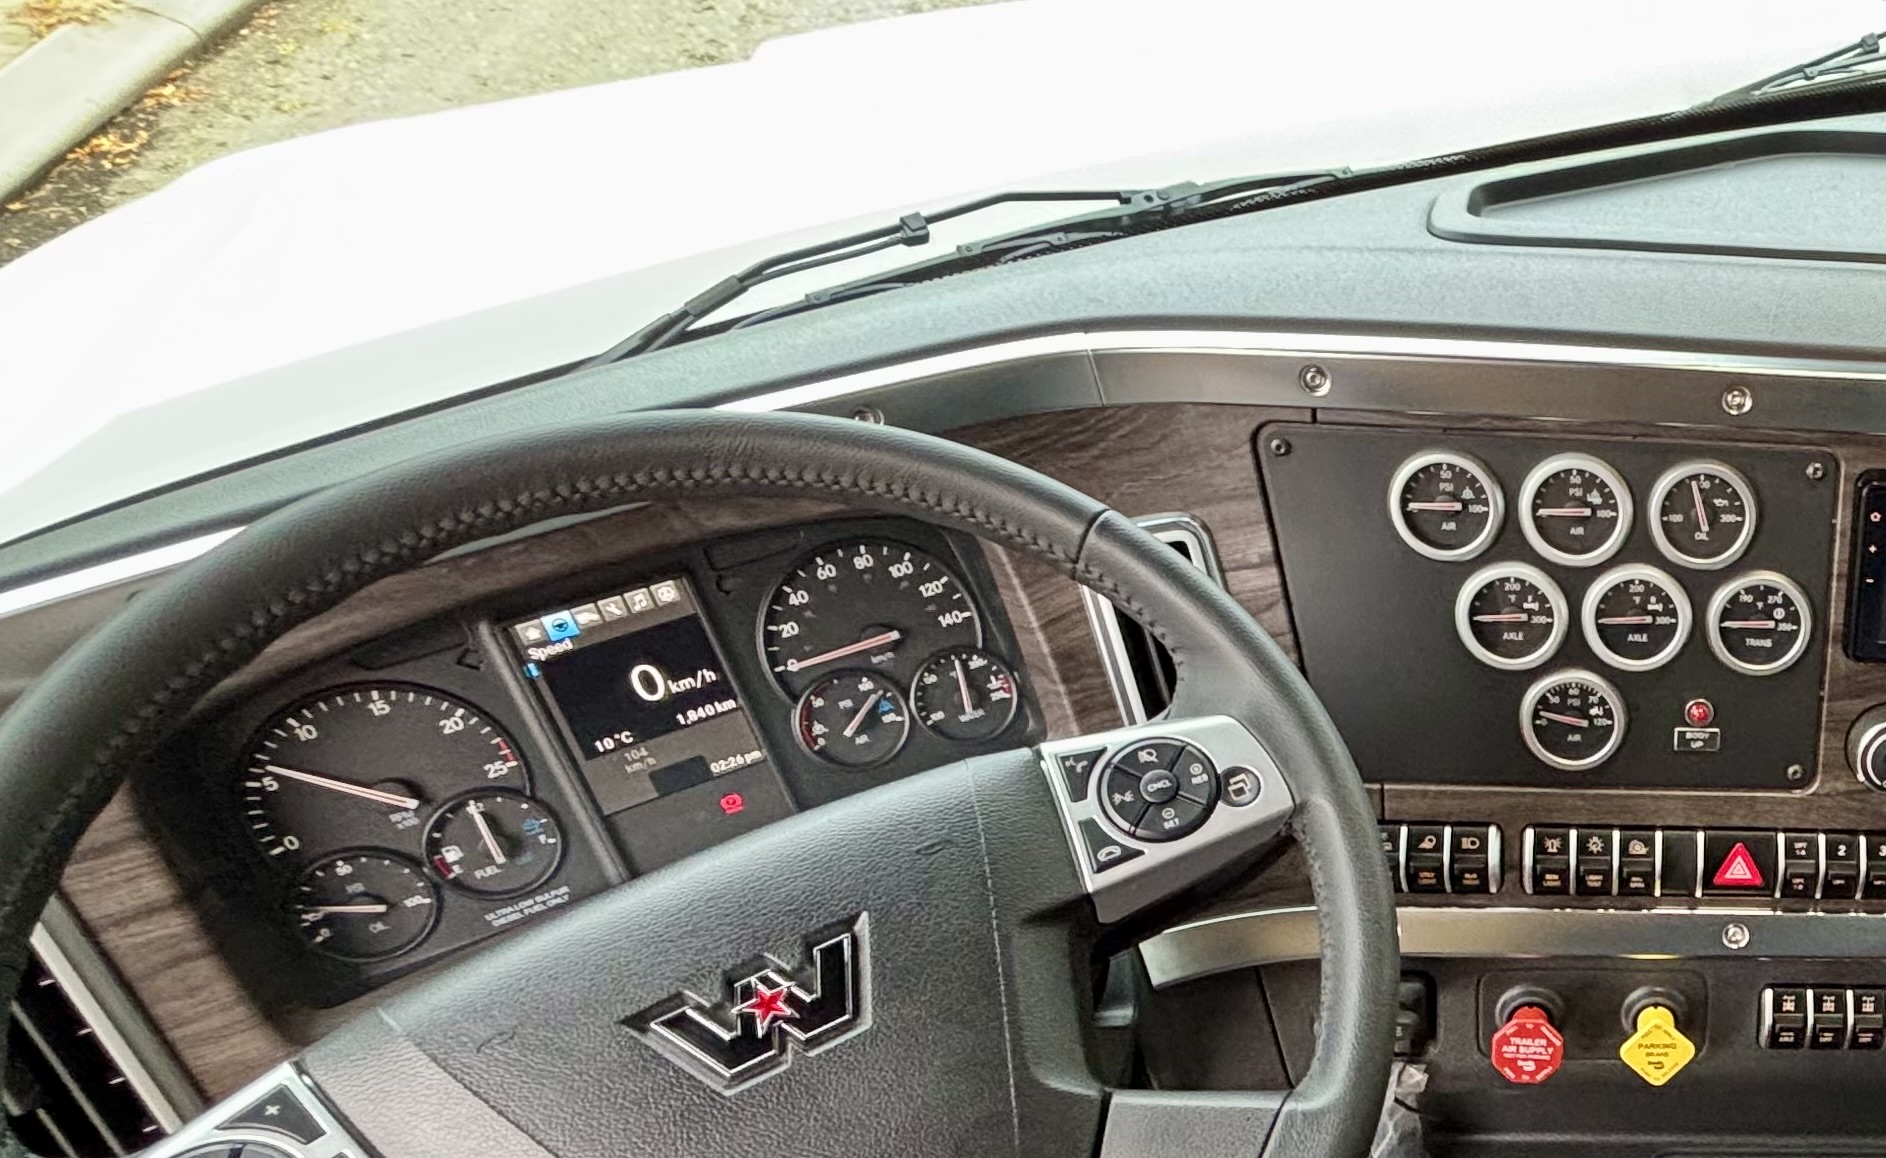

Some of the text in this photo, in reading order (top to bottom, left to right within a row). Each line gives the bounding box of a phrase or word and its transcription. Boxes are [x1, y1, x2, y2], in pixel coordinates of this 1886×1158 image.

[1439, 483, 1453, 492] PSI
[1569, 488, 1583, 497] PSI
[1441, 521, 1456, 531] AIR
[1570, 526, 1585, 536] AIR
[853, 555, 873, 569] 80
[817, 564, 836, 580] 60
[889, 562, 913, 578] 100
[919, 581, 943, 597] 120
[789, 591, 809, 606] 40
[938, 611, 962, 627] 140
[779, 622, 799, 638] 20
[1503, 632, 1524, 641] AXLE
[1627, 634, 1648, 642] AXLE
[1745, 638, 1772, 647] TRANS
[528, 638, 573, 661] Speed
[630, 664, 716, 701] 0 km/h
[368, 700, 391, 716] 15
[676, 698, 736, 726] 1,840 km
[294, 724, 318, 742] 10
[439, 717, 465, 734] 20
[1567, 734, 1581, 742] AIR
[1691, 741, 1704, 749] UP
[483, 762, 508, 778] 25
[262, 776, 279, 792] 5
[283, 836, 299, 851] 0
[1837, 844, 1847, 857] 2
[474, 865, 502, 879] FUEL
[1509, 1036, 1548, 1046] TRAILER
[1501, 1045, 1554, 1055] AIR SUPPLY
